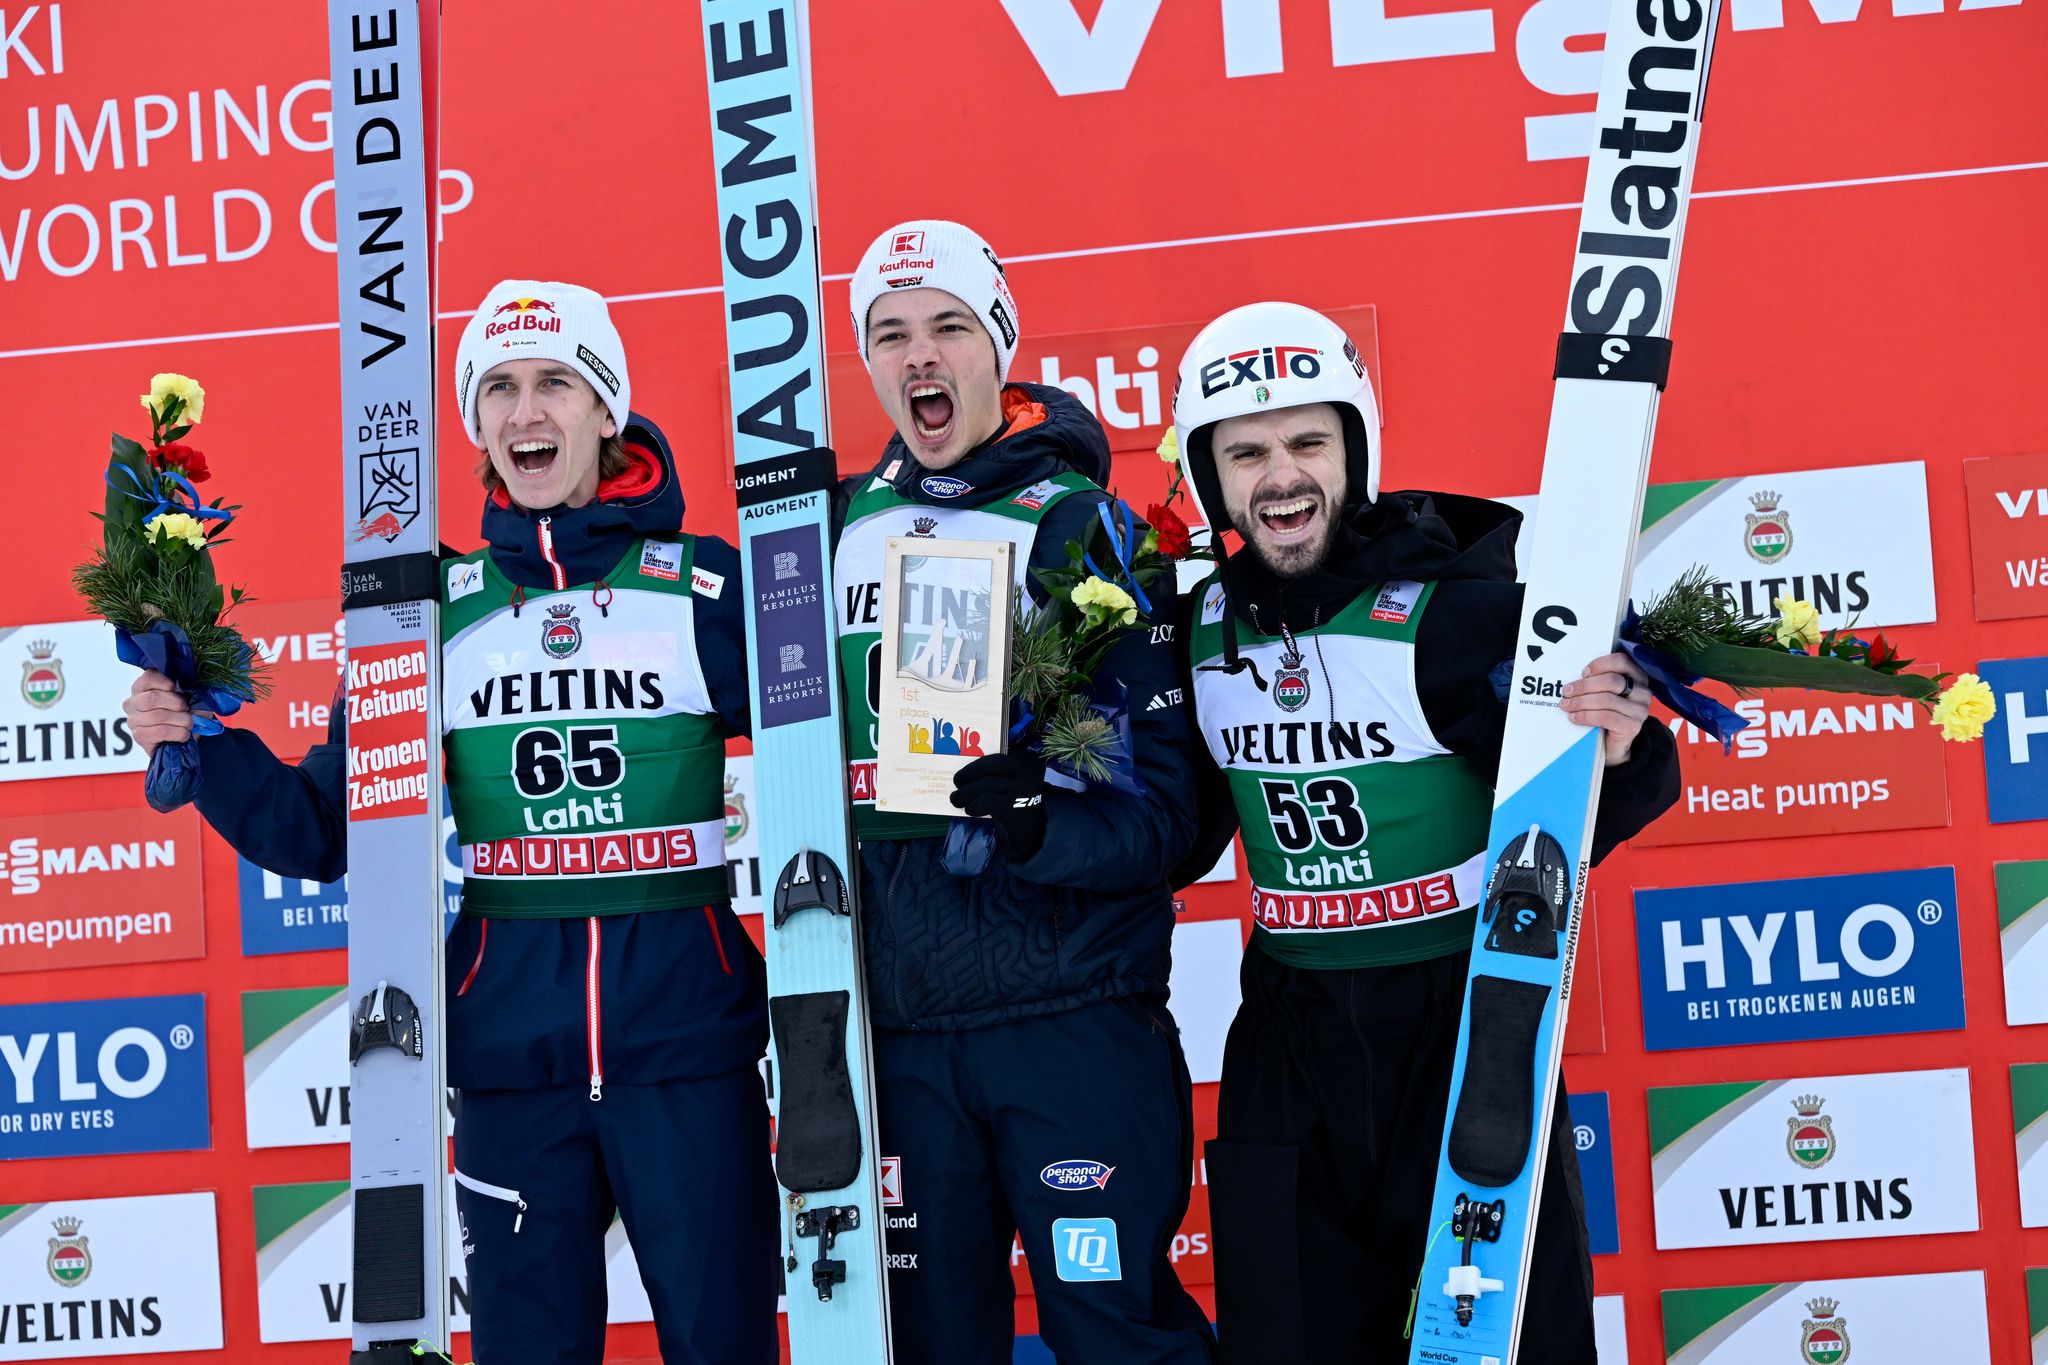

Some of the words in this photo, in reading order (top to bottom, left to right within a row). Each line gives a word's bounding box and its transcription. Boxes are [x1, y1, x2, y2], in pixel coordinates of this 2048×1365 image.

[300, 169, 475, 254] CP
[879, 258, 934, 274] Kaufland
[358, 205, 406, 370] VAN
[904, 276, 923, 286] DSV
[485, 315, 520, 340] Red
[523, 315, 561, 333] Bull
[579, 347, 619, 393] GIESSWEIN
[1040, 346, 1162, 429] hti
[364, 400, 412, 422] VAN
[359, 419, 419, 442] DEER
[926, 480, 965, 490] personal
[932, 486, 954, 494] shop
[744, 495, 818, 521] AUGMENT
[643, 557, 674, 566] JUMPING
[353, 573, 376, 585] VAN
[354, 581, 382, 593] DEER
[761, 584, 817, 602] FAMILUX
[763, 594, 817, 612] RESORTS
[1379, 599, 1408, 609] JUMPING
[1712, 571, 1869, 620] ELTINS
[383, 602, 421, 610] OBSESSION
[348, 650, 426, 690] Kronen
[470, 669, 664, 718] VELTINS
[767, 676, 823, 694] FAMILUX
[769, 686, 823, 704] RESORTS
[348, 685, 427, 724] Zeitung
[900, 707, 930, 720] place
[1221, 721, 1395, 765] VELTINS
[348, 738, 427, 777] Kronen
[512, 725, 626, 800] 65
[349, 772, 428, 811] Zeitung
[1687, 784, 1765, 814] Heat
[1776, 778, 1890, 814] pumps
[524, 793, 624, 832] Lahti
[1258, 776, 1369, 854] 53
[1284, 850, 1374, 886] Lahti
[283, 907, 313, 928] BEI
[1687, 1001, 1719, 1021] BEI
[1727, 991, 1843, 1018] TROCKENEN
[1850, 985, 1916, 1009] AUGEN
[30, 1112, 64, 1133] DRY
[71, 1109, 115, 1129] EYES
[1047, 1166, 1100, 1178] personal
[1058, 1174, 1087, 1185] shop
[1718, 1177, 1912, 1229] VELTINS
[1420, 1350, 1443, 1361] World
[1442, 1352, 1458, 1363] Cup
